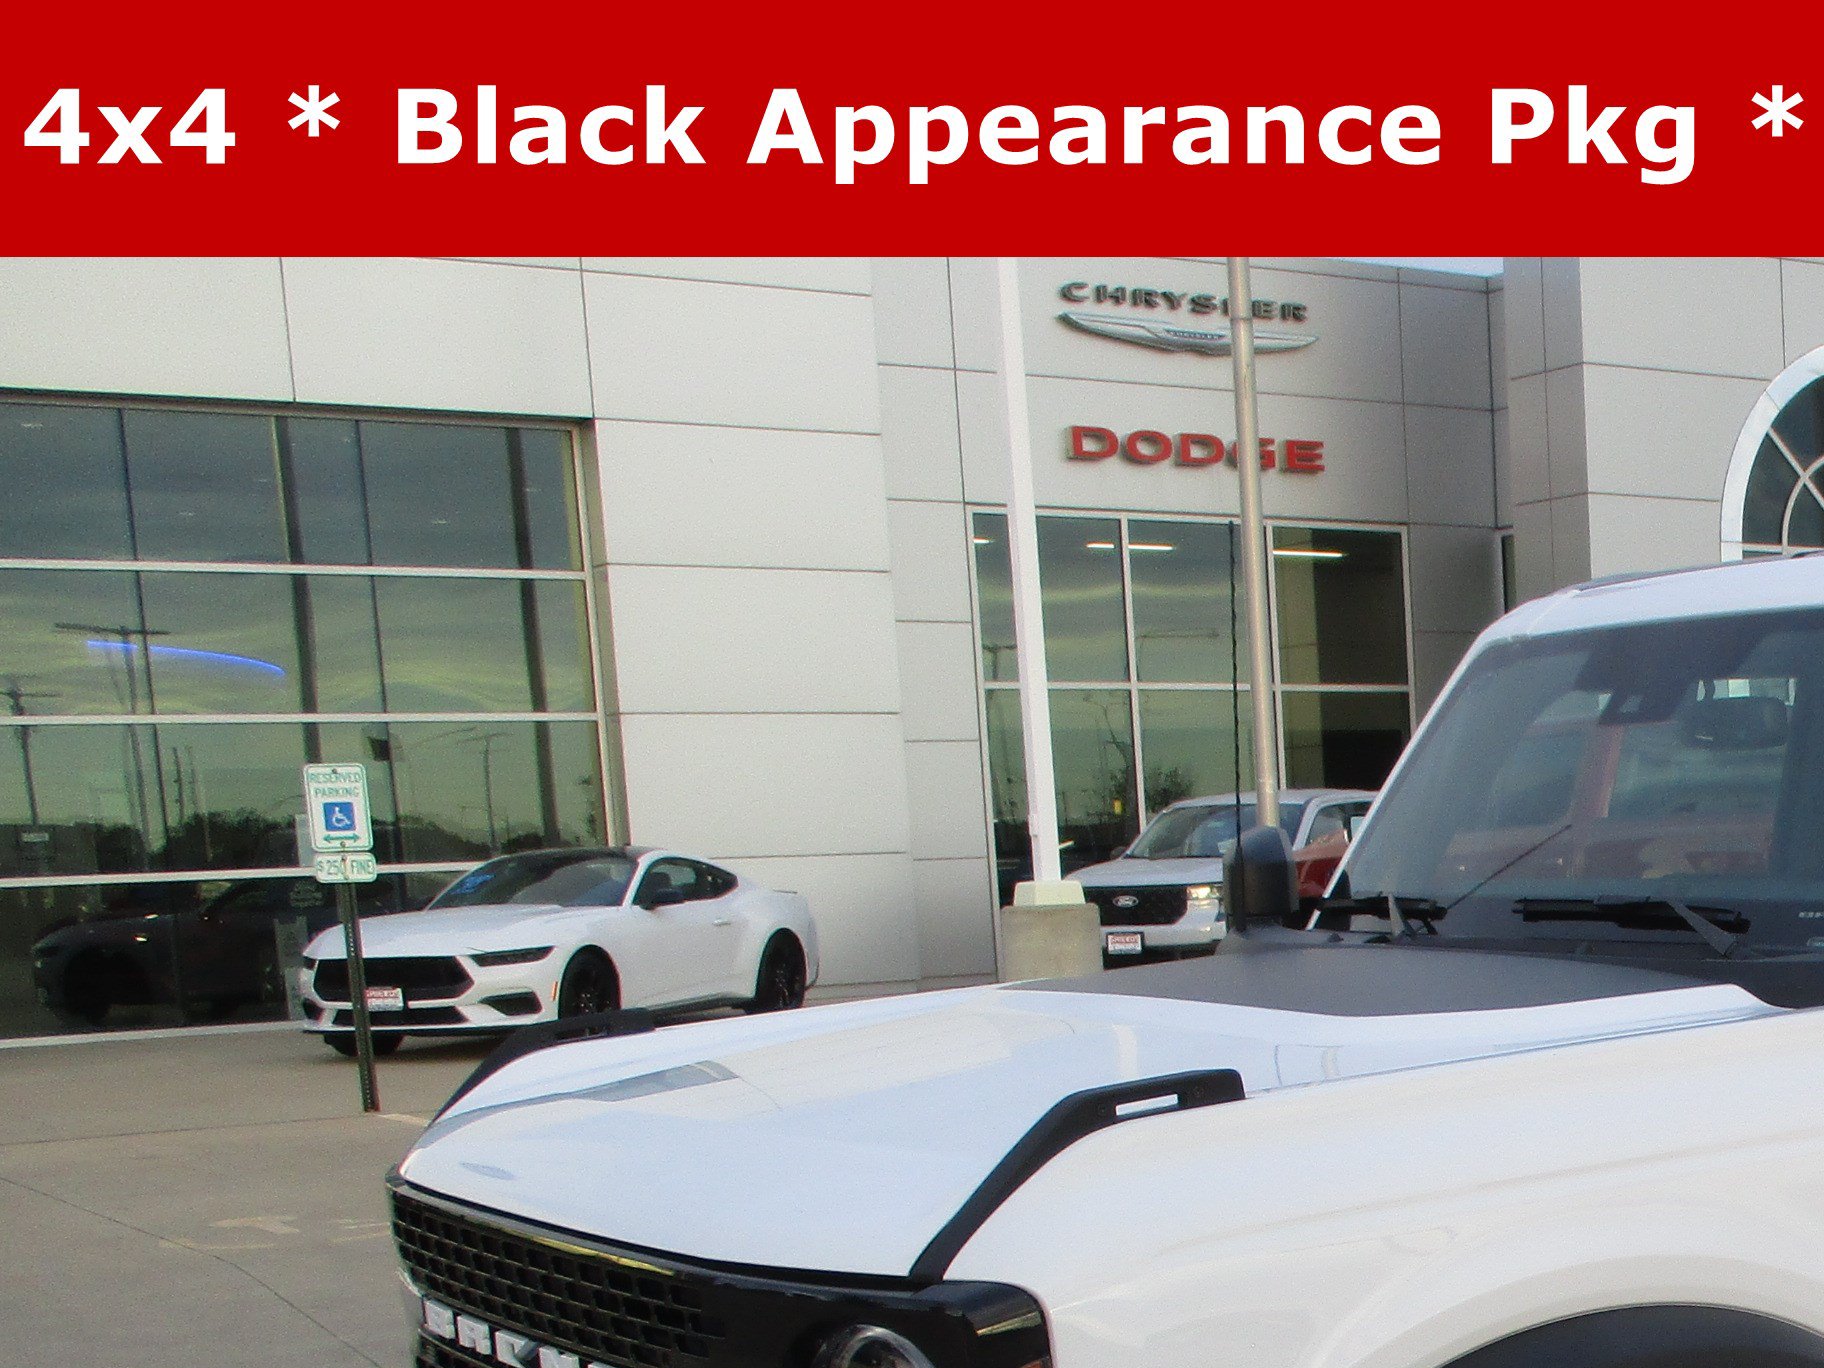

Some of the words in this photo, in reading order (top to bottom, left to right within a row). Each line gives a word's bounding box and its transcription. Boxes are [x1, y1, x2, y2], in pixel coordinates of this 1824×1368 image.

[1065, 425, 1325, 475] DODGE
[309, 772, 362, 783] RESERVED
[314, 787, 359, 797] PARKING
